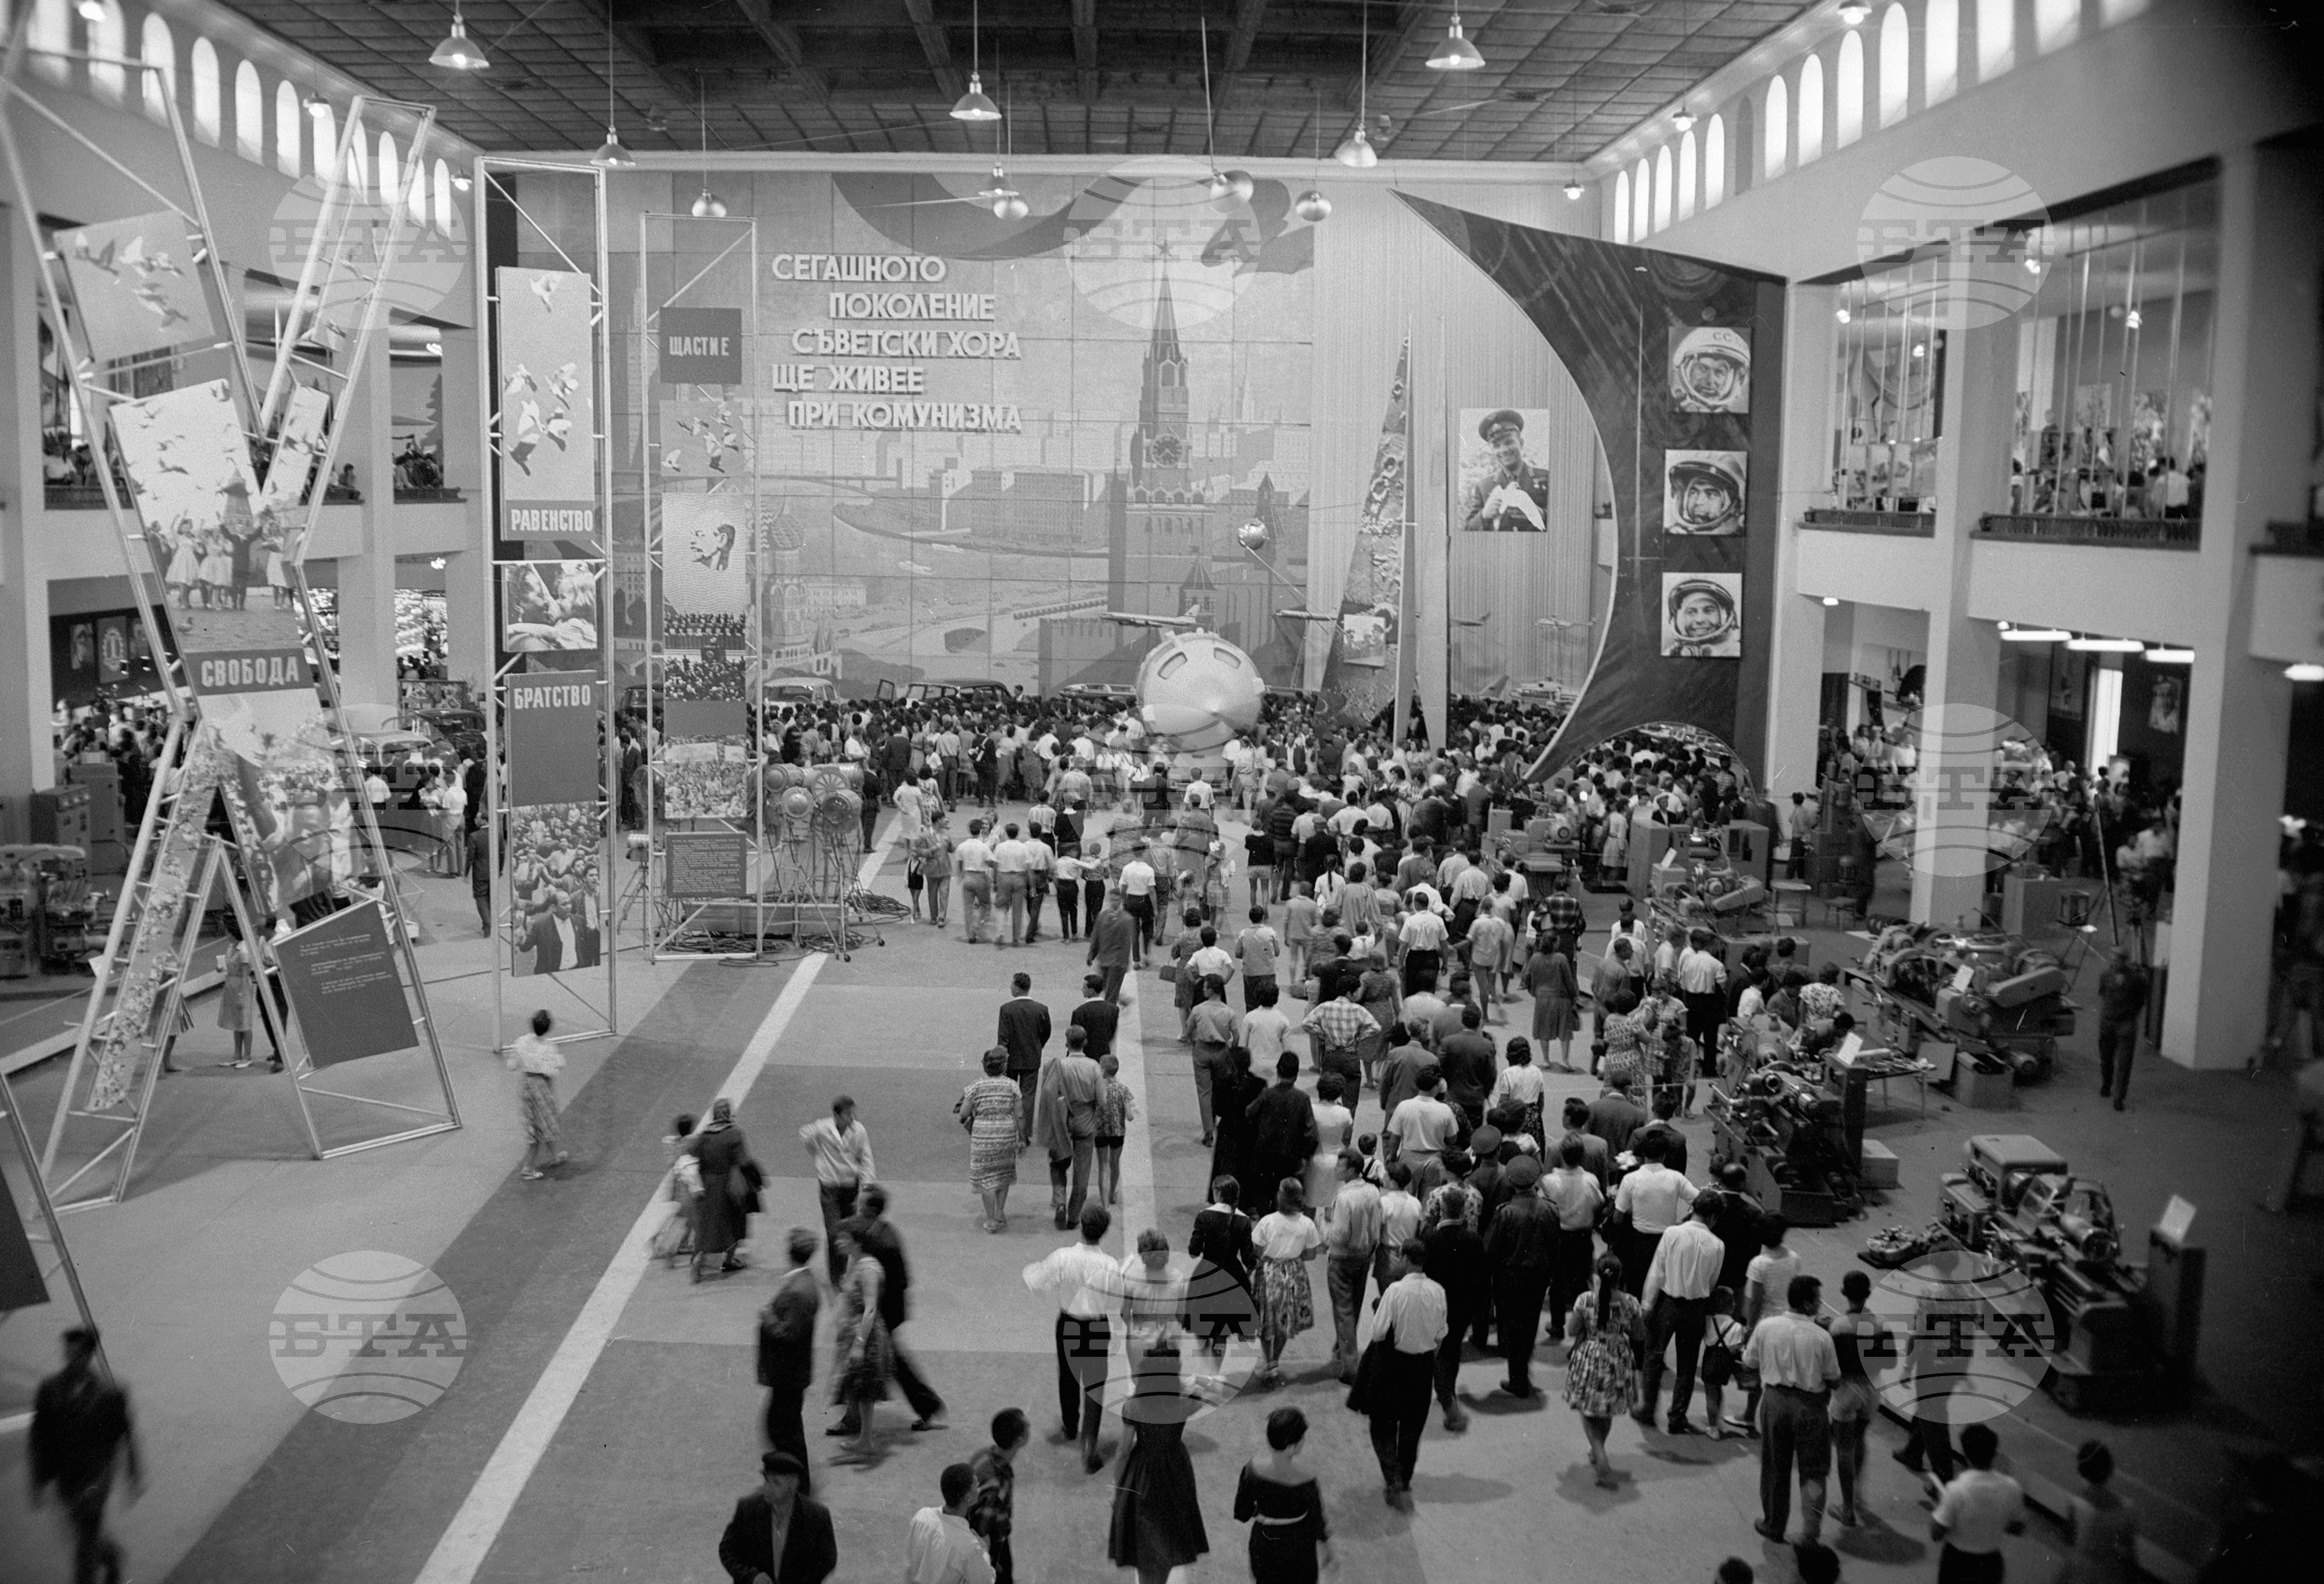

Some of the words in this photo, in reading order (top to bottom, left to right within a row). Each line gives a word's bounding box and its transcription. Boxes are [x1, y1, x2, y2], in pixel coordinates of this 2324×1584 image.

[772, 254, 946, 282] СЕГАШНОТО
[829, 292, 995, 319] ПОКОЛЕНИЕ
[669, 336, 730, 357] ЩАСТИЕ
[791, 328, 938, 357] СЪВЕТСКИ
[946, 330, 1022, 358] ХОРА
[772, 364, 815, 392] ЩЕ
[828, 364, 924, 393] ЖИВЕЕ
[788, 400, 840, 427] ПРИ
[851, 402, 1022, 430] КОМУНИЗМА
[511, 509, 593, 532] РАВЕНСТВО
[201, 657, 299, 687] СВОБОДА
[514, 684, 591, 710] БРАТСТВО
